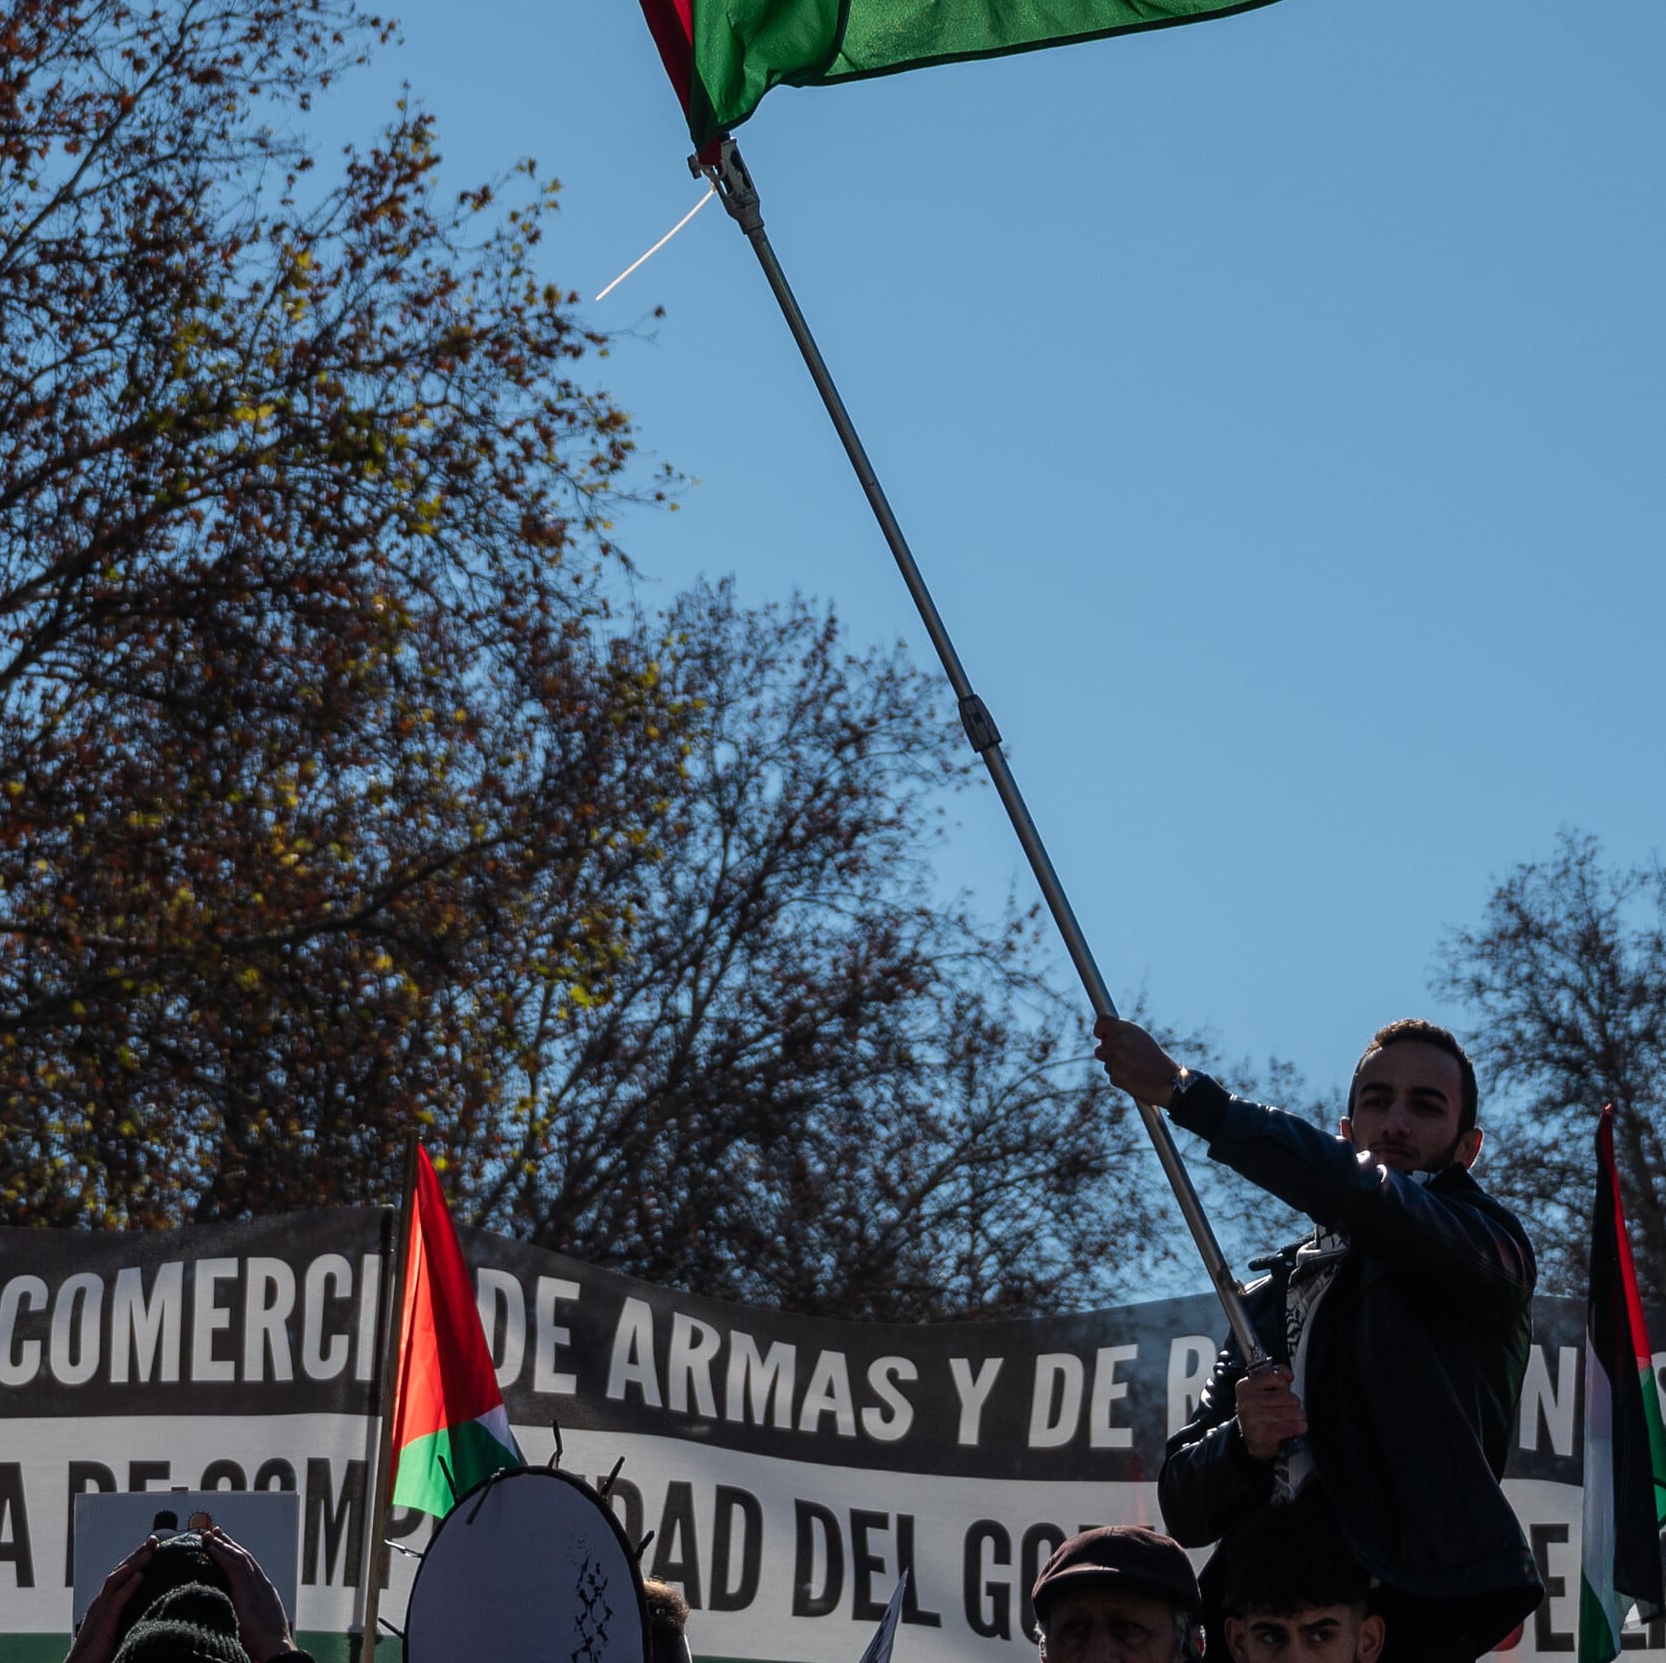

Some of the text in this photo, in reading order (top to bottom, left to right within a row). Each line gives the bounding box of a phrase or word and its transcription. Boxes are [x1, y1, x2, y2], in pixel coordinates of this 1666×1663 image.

[476, 1267, 581, 1395] DE
[606, 1296, 918, 1442] ARMAS
[948, 1357, 1004, 1446] Y
[1028, 1343, 1139, 1449] DE
[792, 1498, 941, 1628] DEL
